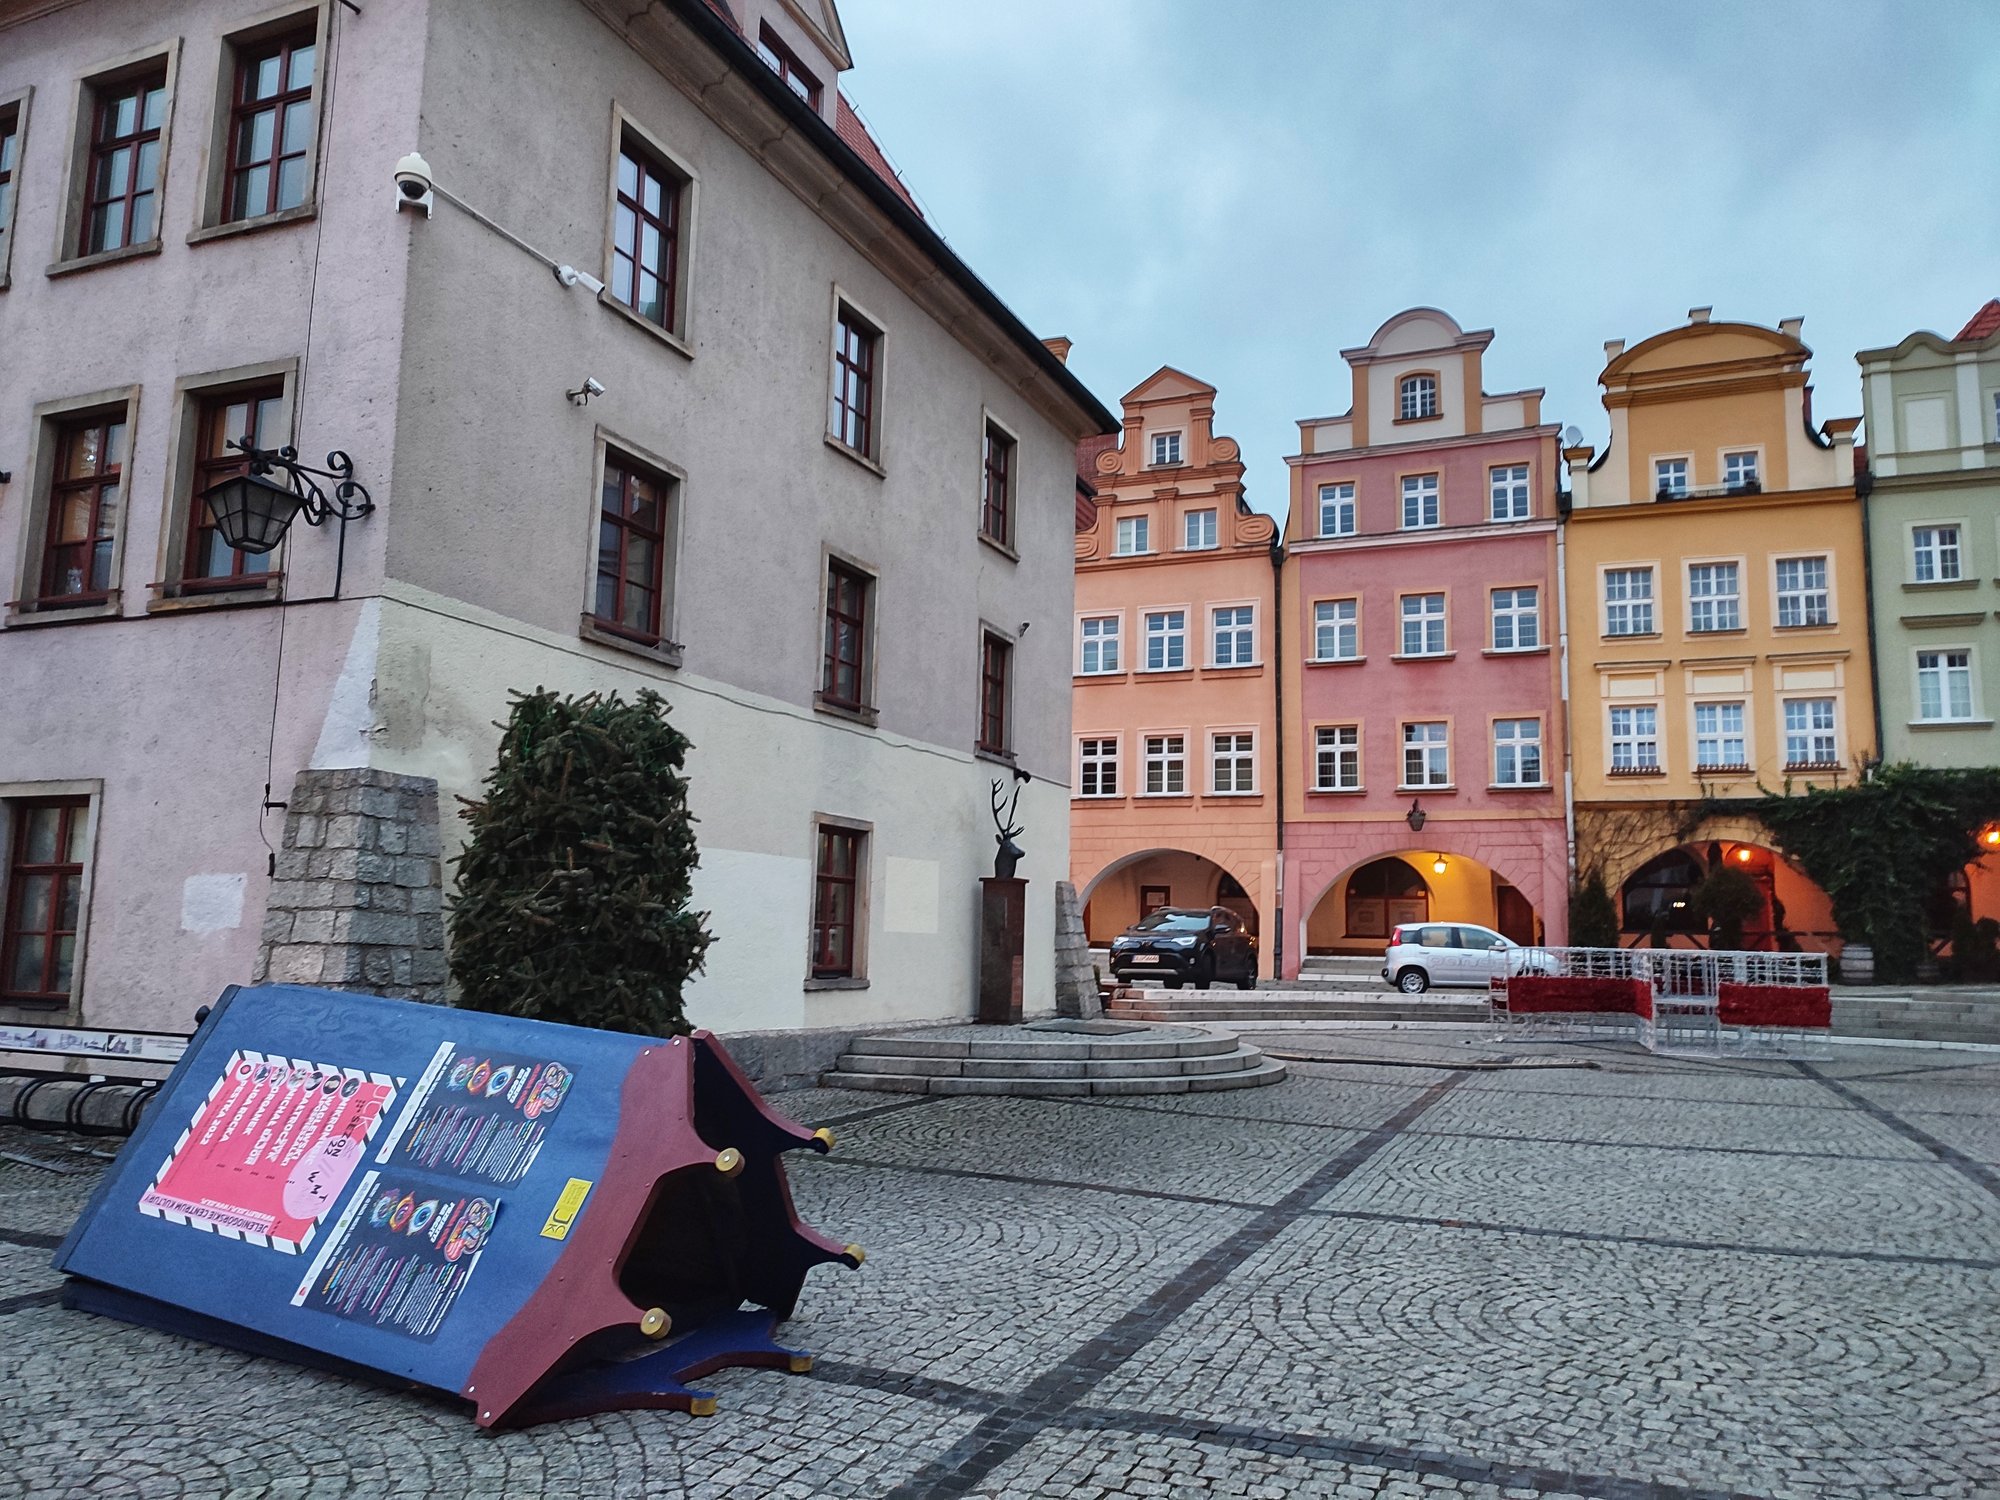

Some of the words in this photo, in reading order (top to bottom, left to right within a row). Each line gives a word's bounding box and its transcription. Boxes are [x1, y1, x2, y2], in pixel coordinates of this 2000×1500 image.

[215, 1079, 247, 1118] PESTKA
[241, 1085, 280, 1135] ORGANEK
[198, 1118, 222, 1145] 2022
[218, 1106, 247, 1143] ROCKA
[329, 1115, 361, 1157] SEZON
[322, 1140, 337, 1155] 22
[140, 1192, 177, 1209] KULTURY
[174, 1202, 210, 1218] CENTRUM
[206, 1211, 268, 1234] JELENIOGÓRSKIE
